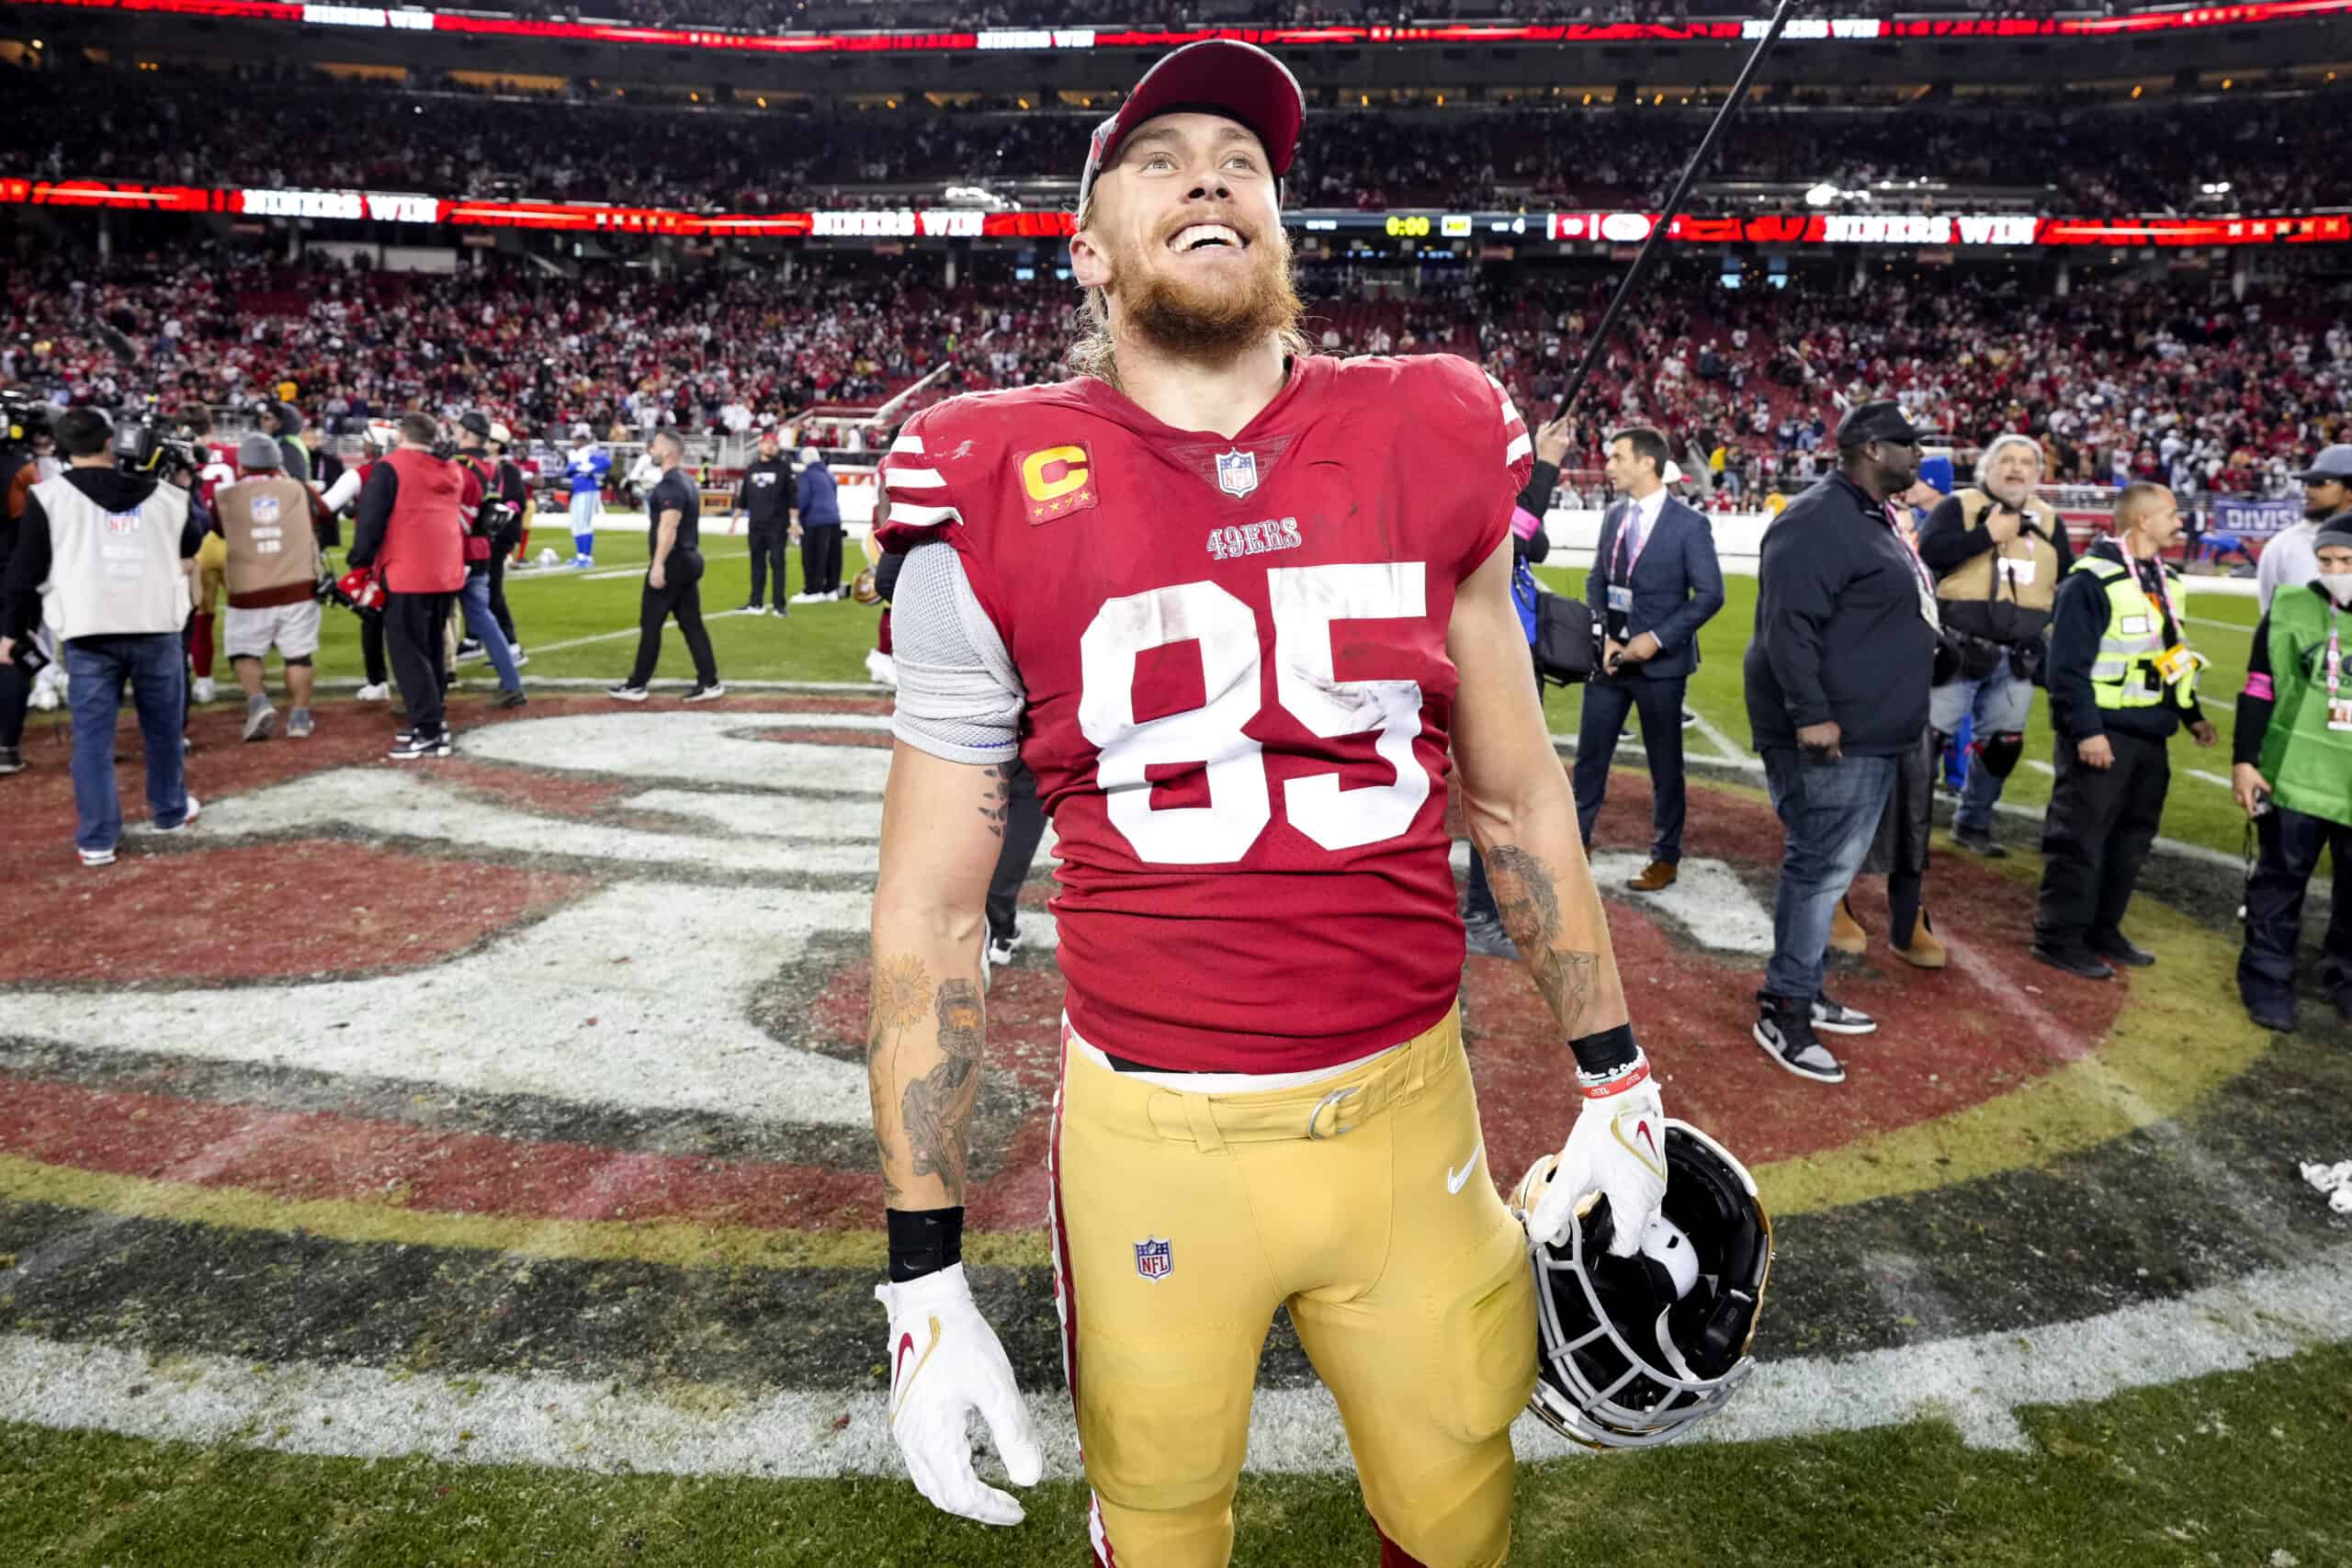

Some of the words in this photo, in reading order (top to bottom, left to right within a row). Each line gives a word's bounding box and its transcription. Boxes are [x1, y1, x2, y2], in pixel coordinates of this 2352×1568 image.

[243, 189, 362, 220] NINERS
[366, 195, 439, 222] WIN
[812, 211, 915, 236] NINERS
[920, 211, 985, 236] WIN
[1386, 216, 1430, 235] 0:00
[1824, 216, 1951, 243] NINERS
[1957, 216, 2037, 243] WIN
[1023, 446, 1088, 502] C
[1223, 468, 1254, 489] NFL
[1206, 516, 1302, 560] 49ERS
[1079, 562, 1430, 863] 85
[1142, 1257, 1168, 1274] NFL
